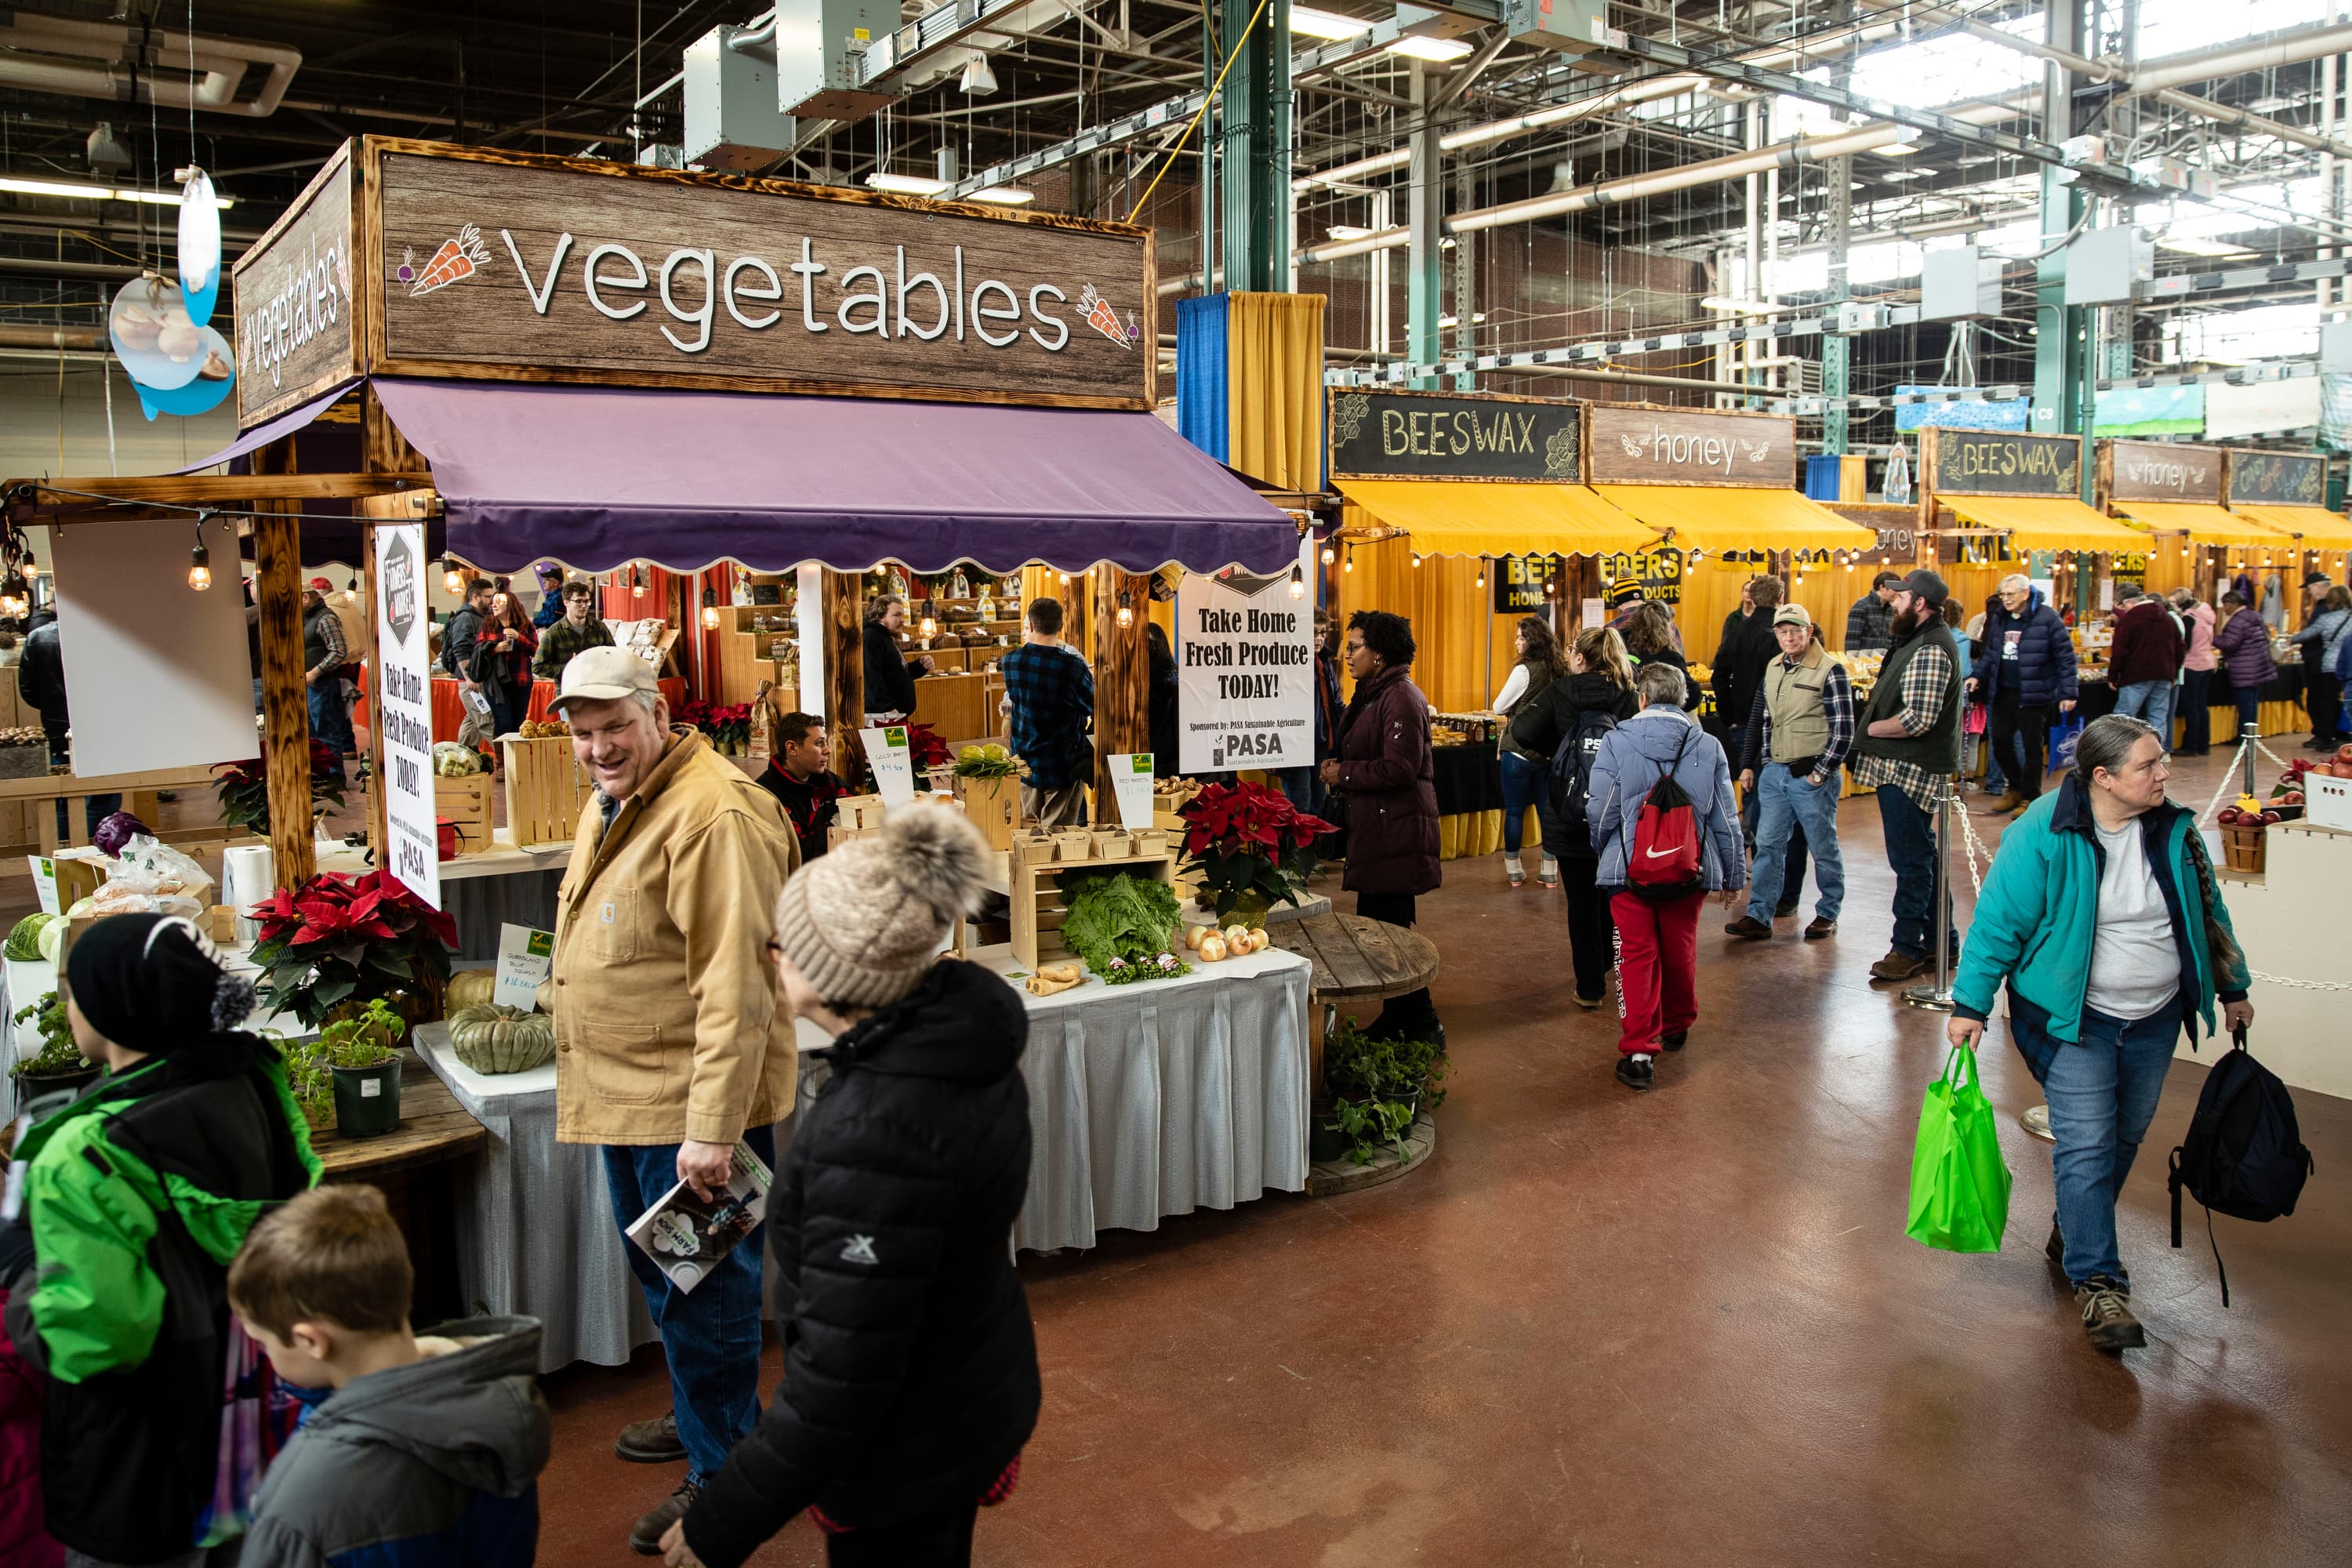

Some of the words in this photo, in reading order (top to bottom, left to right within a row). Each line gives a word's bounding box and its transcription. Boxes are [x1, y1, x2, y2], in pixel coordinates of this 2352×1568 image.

[2038, 407, 2053, 419] C9
[1382, 409, 1537, 456] BEESWAX
[1655, 424, 1737, 476] honey
[1963, 442, 2060, 476] BEESWAX
[2144, 456, 2188, 493] honey
[1865, 521, 1917, 557] oney
[1199, 608, 1242, 633] Take
[1247, 609, 1296, 633] Home
[1185, 642, 1232, 666] Fresh
[1239, 642, 1308, 666] Produce
[386, 662, 401, 698] Take
[402, 666, 422, 706] Home
[1218, 674, 1279, 699] TODAY!
[383, 706, 400, 743] Fresh
[401, 712, 429, 756] Produce
[1190, 722, 1218, 731] Sponsored
[1230, 720, 1243, 729] PASA
[1245, 720, 1275, 728] Sustainable
[1276, 719, 1305, 728] Agriculture
[1227, 733, 1283, 757] PASA
[396, 754, 419, 798] TODAY!
[403, 838, 426, 881] PASA
[507, 953, 541, 964] QUEENSLAND
[671, 1232, 695, 1253] FARM
